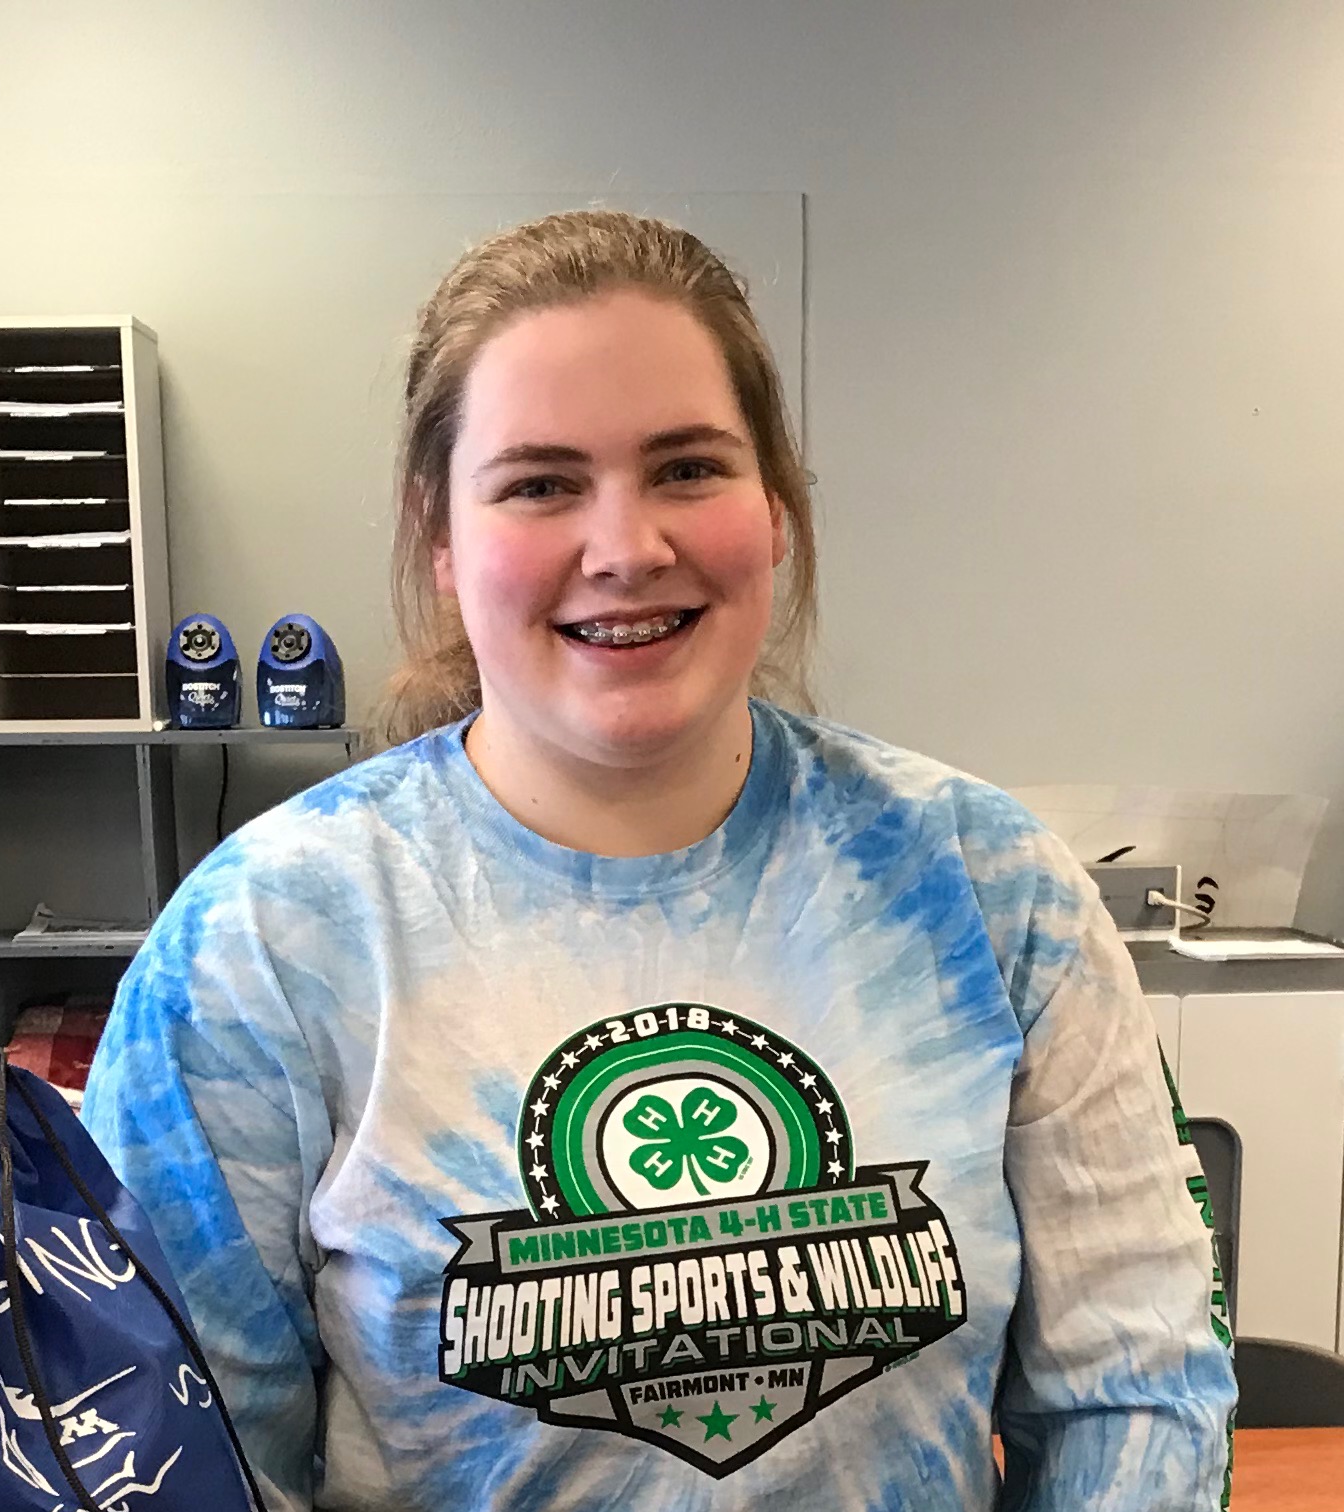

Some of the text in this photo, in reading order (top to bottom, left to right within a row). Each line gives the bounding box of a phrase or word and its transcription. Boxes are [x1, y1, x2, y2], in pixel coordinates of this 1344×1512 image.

[637, 1106, 668, 1131] H
[691, 1098, 721, 1126] H
[643, 1150, 674, 1178] H
[706, 1145, 736, 1170] H
[508, 1191, 888, 1265] MINNESOTA 4-H STATE
[445, 1219, 963, 1376] SHOOTING SPORTS & WILDLIFE
[501, 1316, 921, 1395] INVITATIONAL
[629, 1367, 805, 1405] FAIRMONT MN
